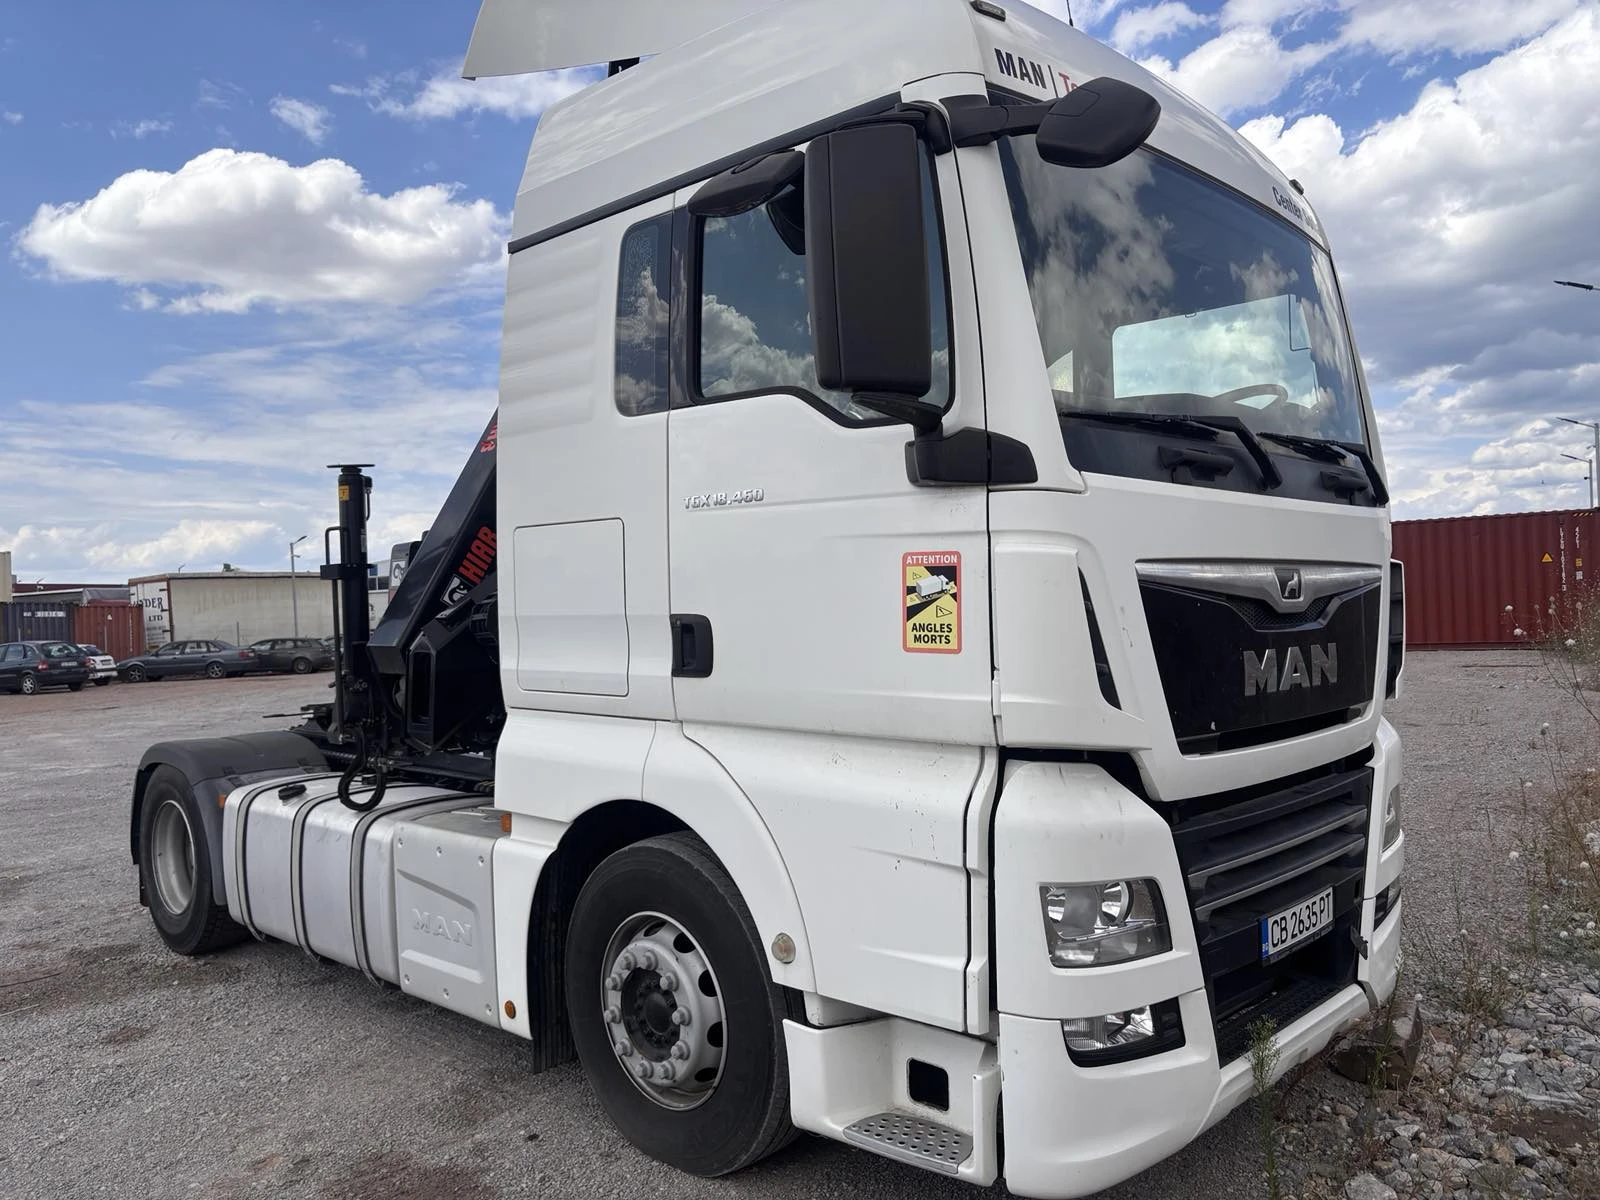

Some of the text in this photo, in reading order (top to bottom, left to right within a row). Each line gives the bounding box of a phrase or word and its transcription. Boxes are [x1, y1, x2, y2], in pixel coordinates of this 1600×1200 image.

[994, 48, 1047, 89] MAN
[683, 494, 711, 509] TGX
[906, 554, 958, 564] ATTENTION
[148, 614, 163, 622] LTD
[911, 622, 953, 633] ANGLES
[913, 634, 951, 645] MORTS
[1243, 642, 1338, 696] MAN
[412, 908, 472, 947] MAN
[1271, 892, 1331, 948] CB 2635 PT
